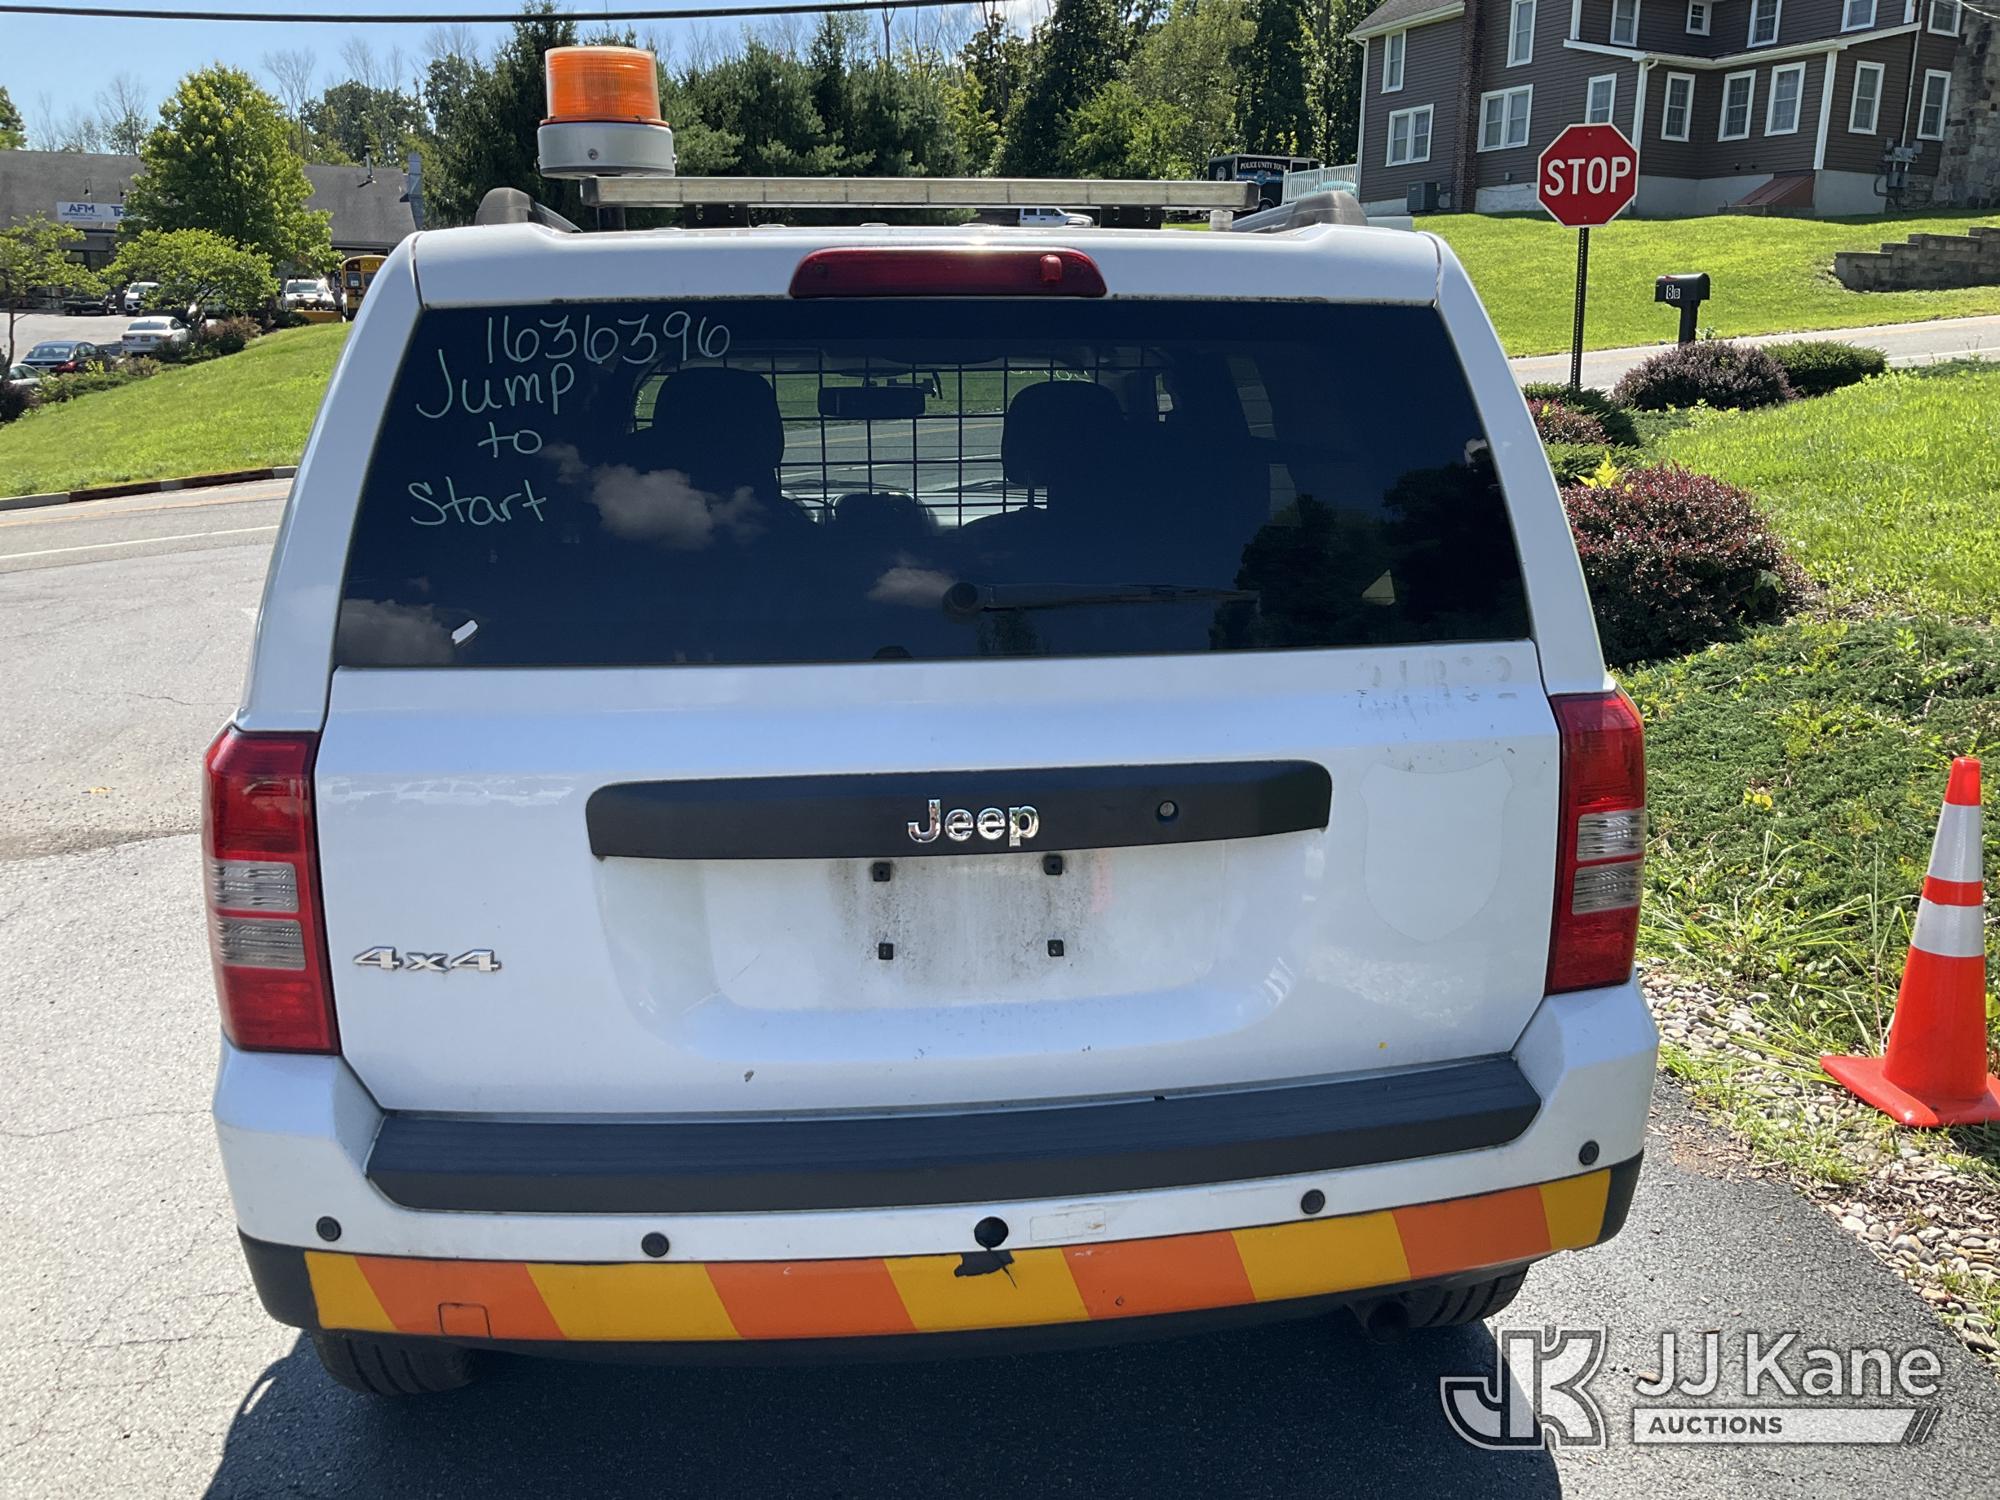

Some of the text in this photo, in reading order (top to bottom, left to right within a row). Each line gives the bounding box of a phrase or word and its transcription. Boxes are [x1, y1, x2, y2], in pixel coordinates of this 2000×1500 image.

[1240, 161, 1257, 170] POLICE
[1257, 161, 1273, 169] UNITY
[1544, 157, 1631, 196] STOP
[68, 204, 95, 213] AFM
[487, 310, 731, 365] 1636396
[415, 348, 575, 418] Jump
[477, 421, 543, 458] to
[407, 475, 548, 526] Start
[907, 799, 1040, 847] Jeep
[352, 946, 503, 973] 4x4
